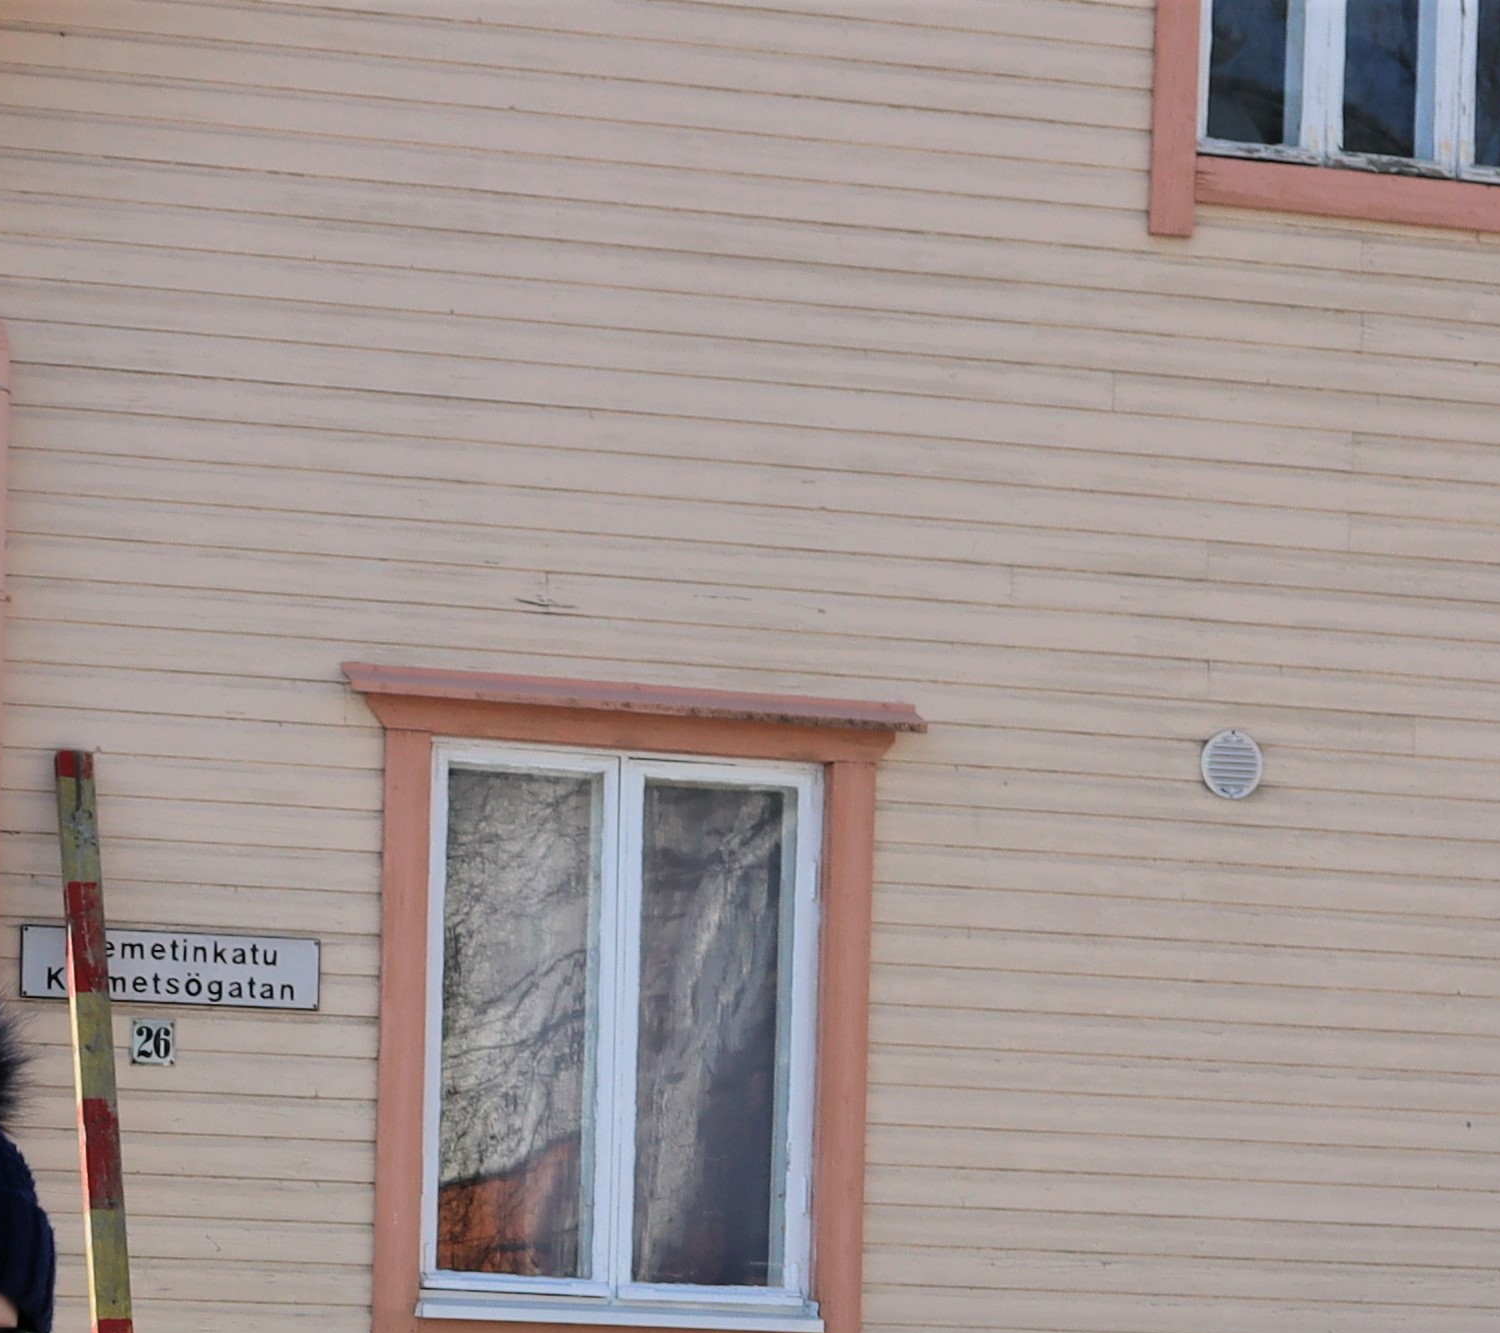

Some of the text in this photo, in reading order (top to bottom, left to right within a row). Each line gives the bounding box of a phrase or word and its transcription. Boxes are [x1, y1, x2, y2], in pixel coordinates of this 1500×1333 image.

[104, 938, 278, 967] emetinkatu
[47, 966, 295, 1003] Kmetsögatan
[135, 1025, 172, 1060] 26
